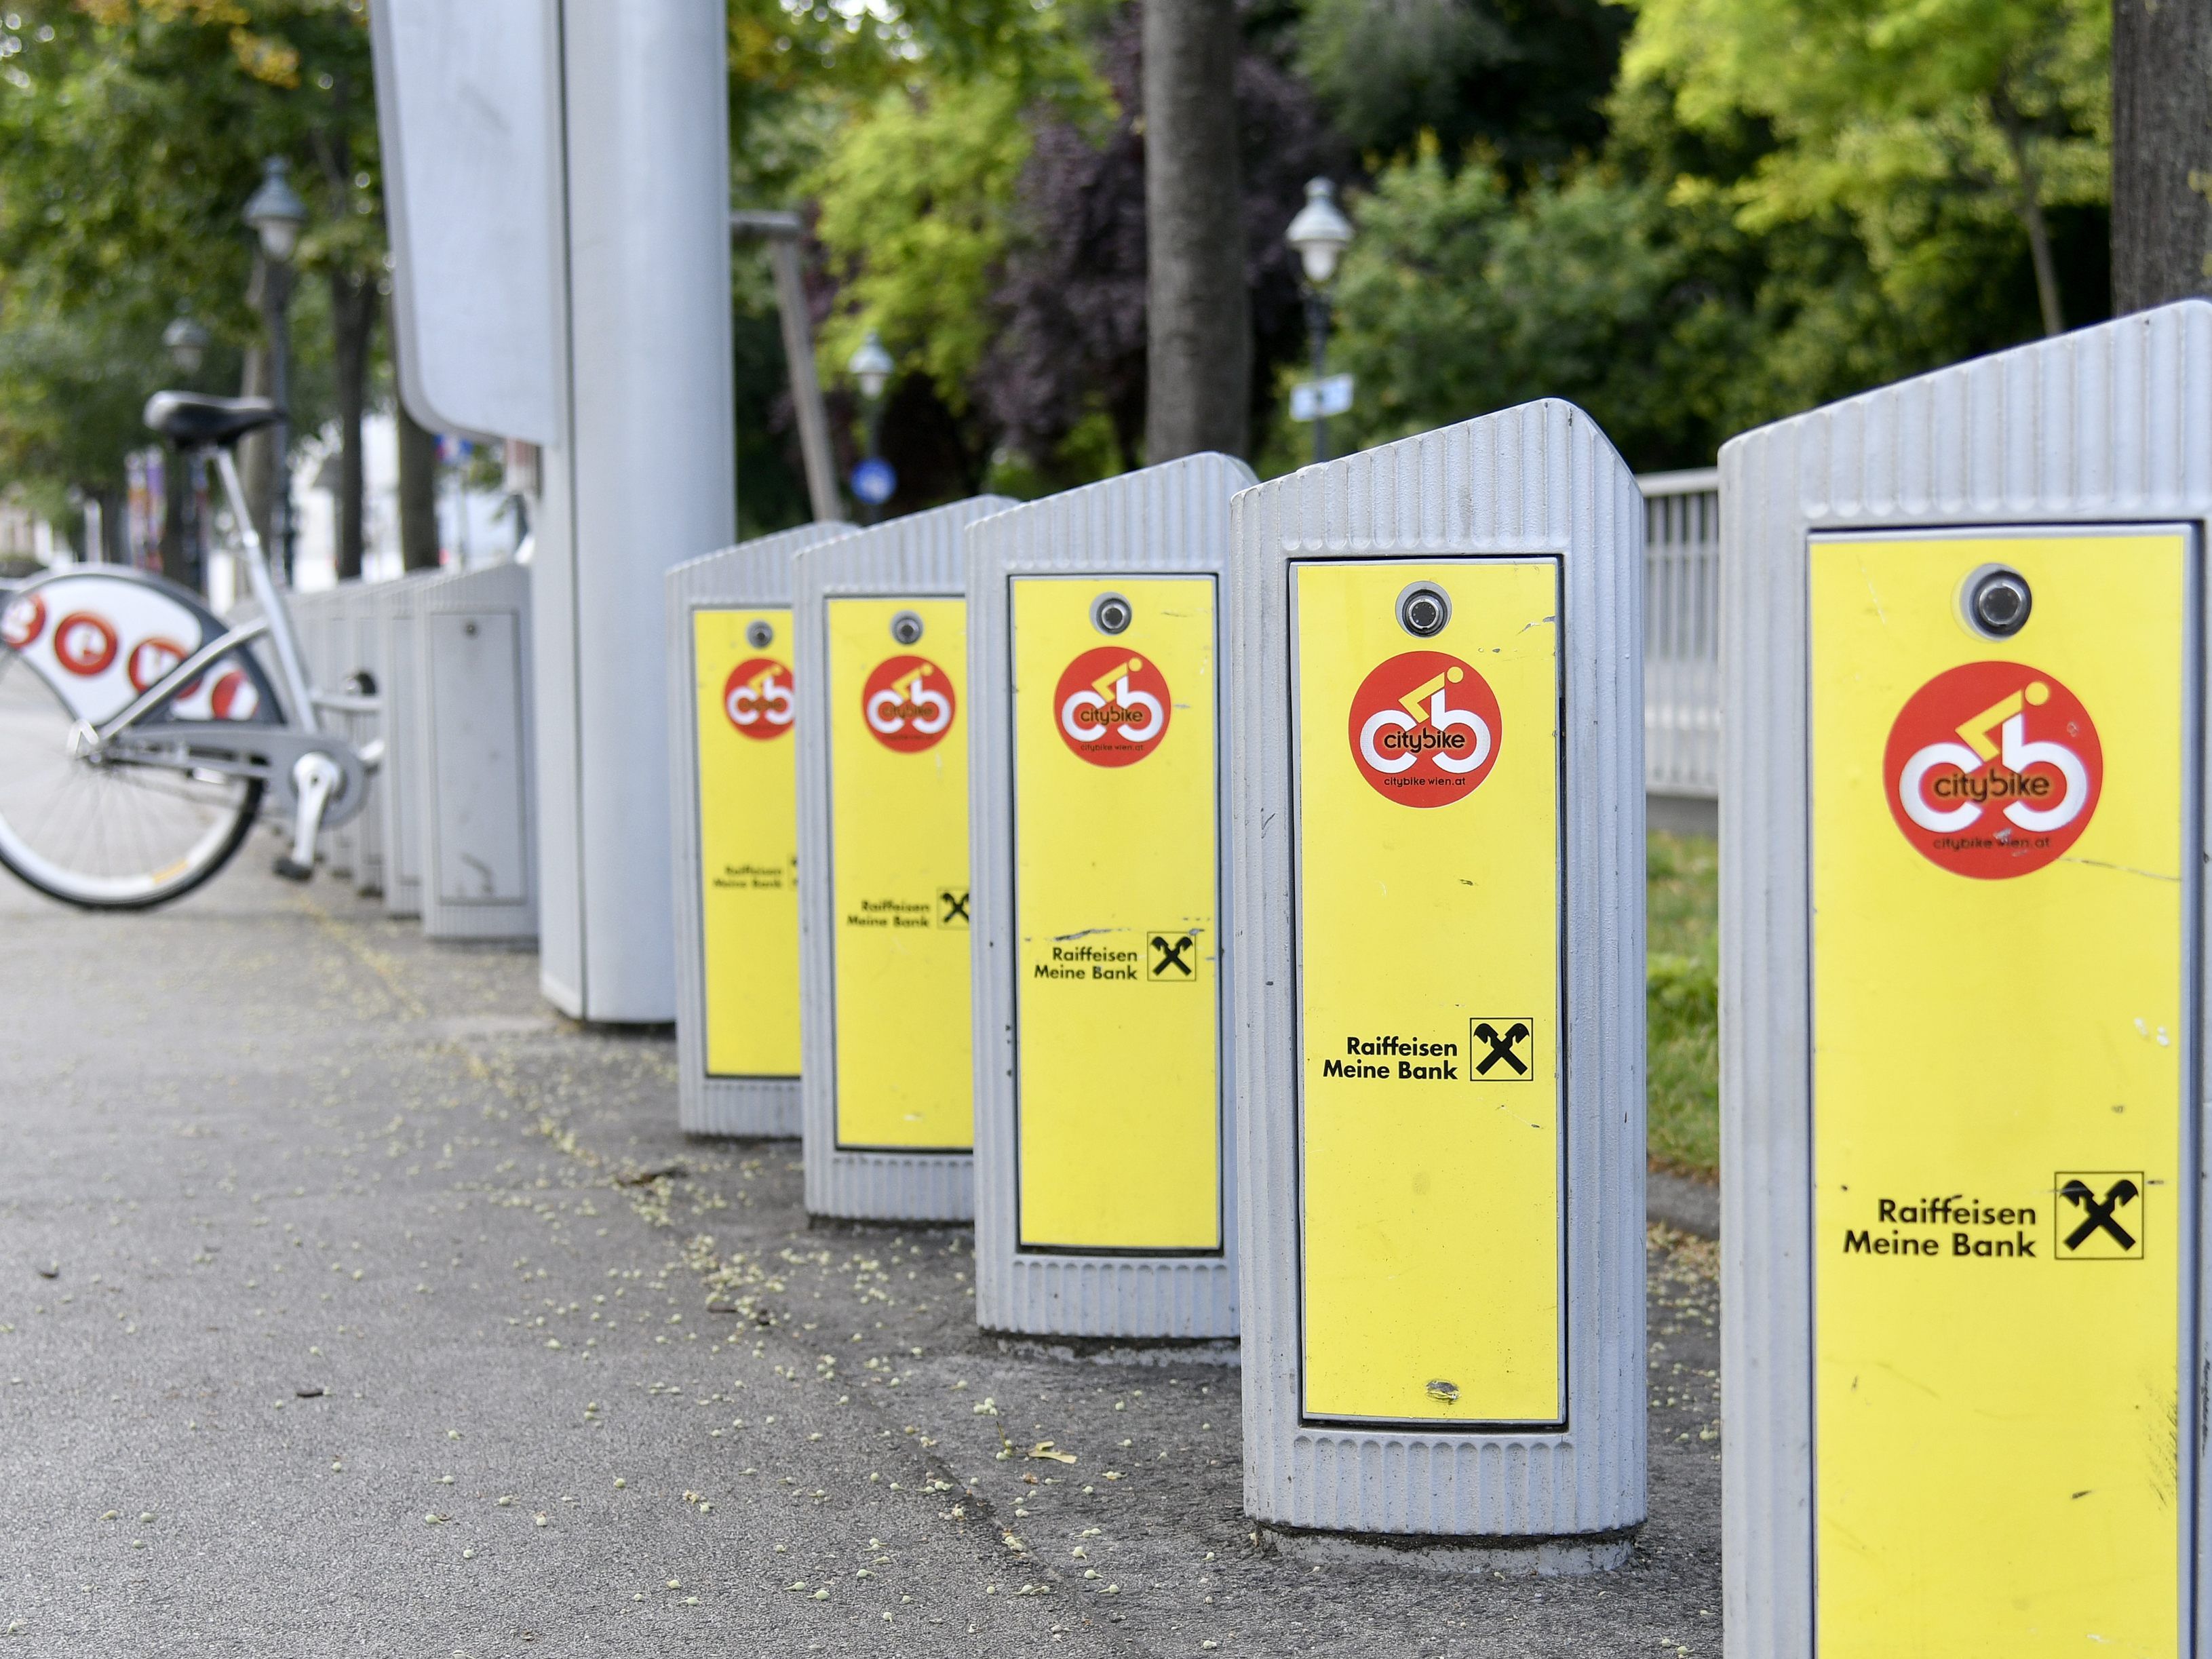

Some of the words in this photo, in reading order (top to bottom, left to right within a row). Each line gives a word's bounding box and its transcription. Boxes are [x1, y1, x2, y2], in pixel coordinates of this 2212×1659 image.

[1081, 706, 1143, 725] citybike
[1384, 727, 1465, 753] citybike
[1935, 768, 2049, 803] citybike
[1053, 947, 1138, 962] Raiffeisen
[1034, 964, 1085, 979] Meine
[1092, 964, 1138, 979] Bank
[1347, 1036, 1458, 1057] Raiffeisen
[1323, 1059, 1390, 1078] Meine
[1398, 1059, 1458, 1080] Bank
[1878, 1197, 2036, 1226] Raiffeisen
[1843, 1230, 1939, 1255] Meine
[1952, 1230, 2036, 1257] Bank
